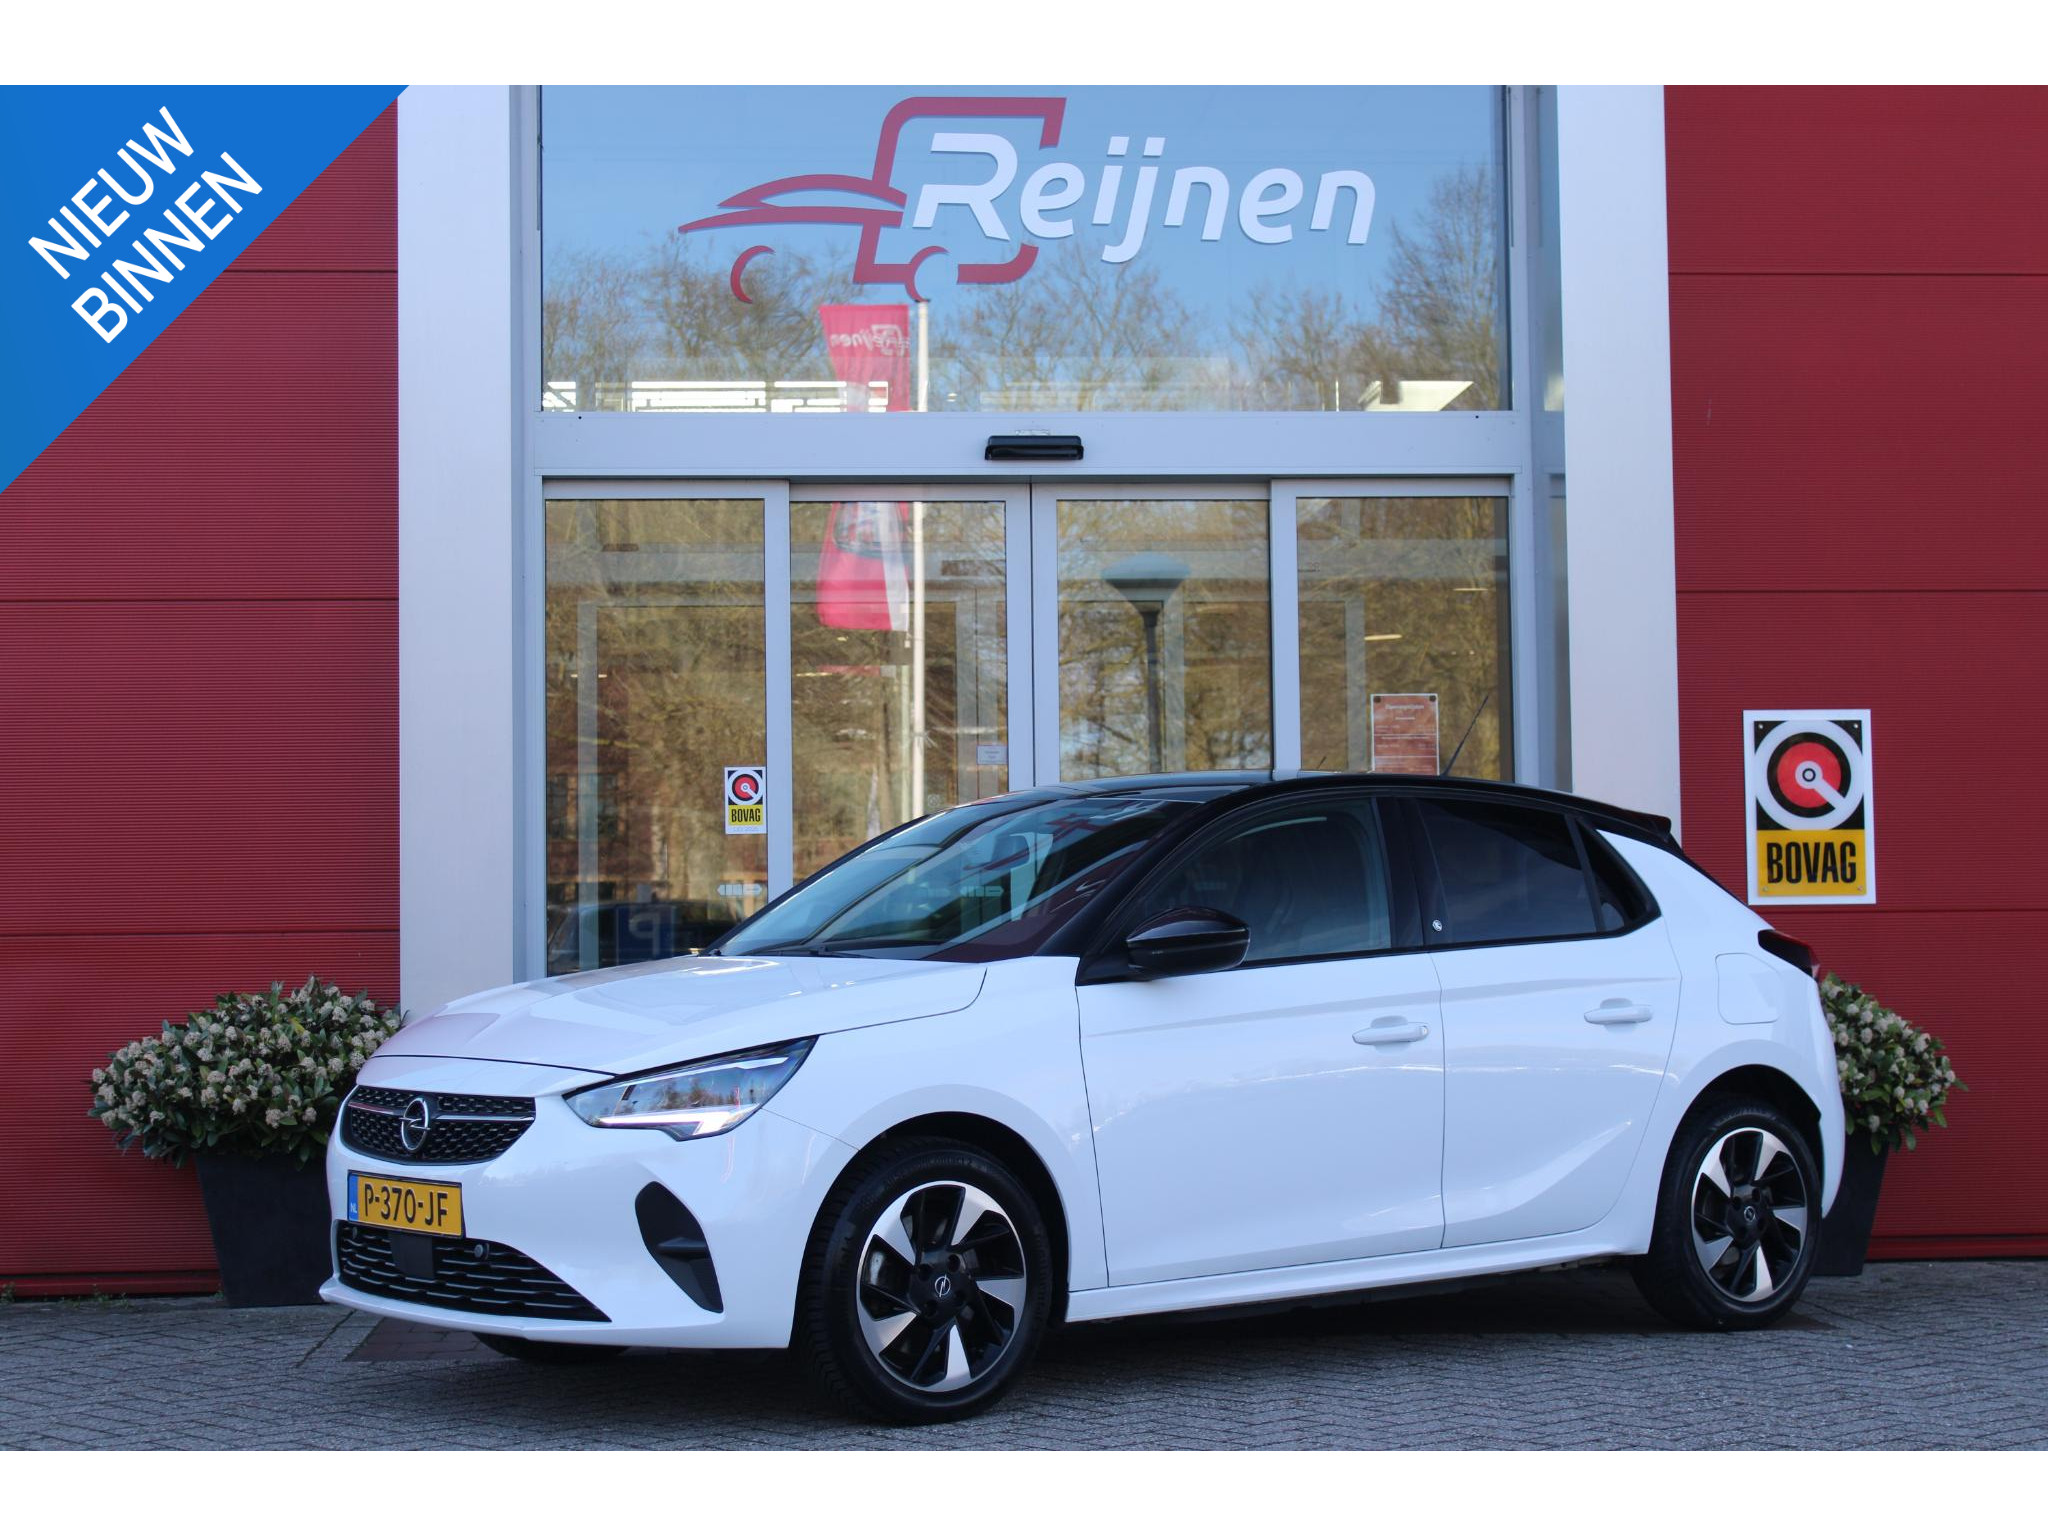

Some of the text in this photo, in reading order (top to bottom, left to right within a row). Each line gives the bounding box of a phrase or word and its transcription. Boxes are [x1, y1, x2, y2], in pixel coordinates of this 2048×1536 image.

[911, 132, 1377, 264] Reijnen
[731, 808, 761, 823] BOVAG
[1766, 841, 1857, 884] BOVAG
[350, 1201, 358, 1214] NL
[363, 1183, 449, 1227] P-370-JF
